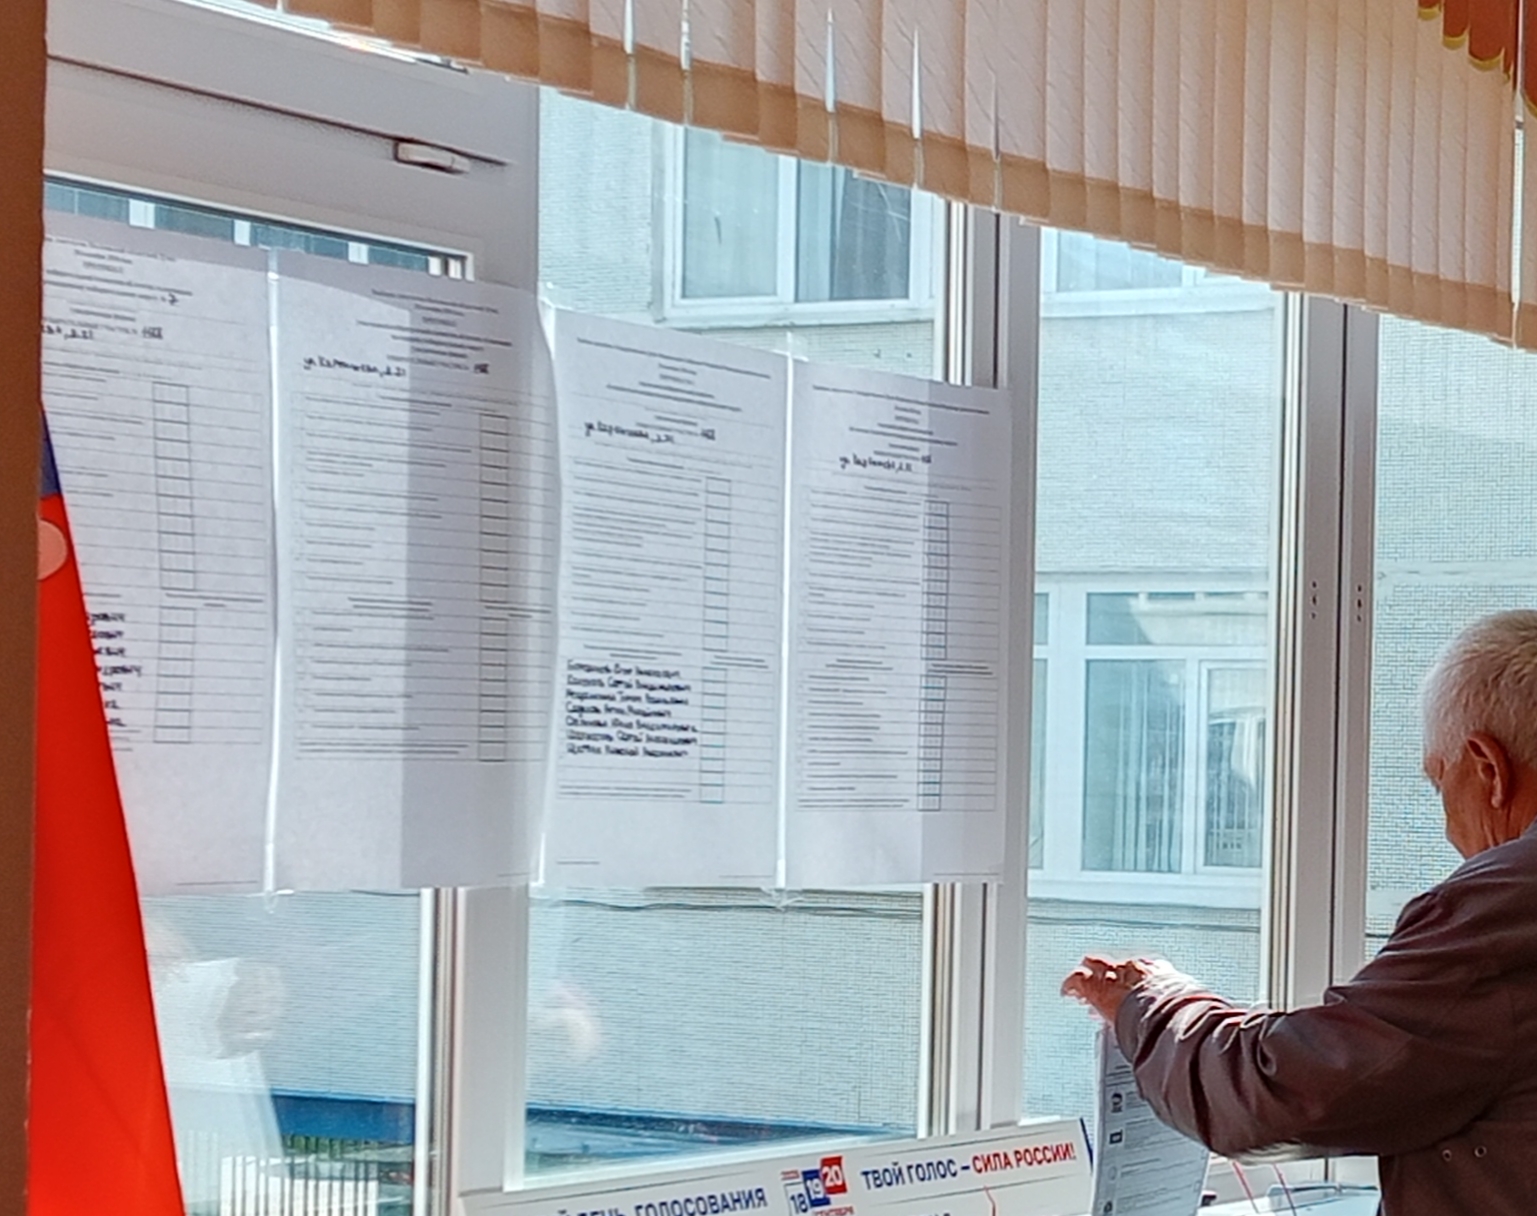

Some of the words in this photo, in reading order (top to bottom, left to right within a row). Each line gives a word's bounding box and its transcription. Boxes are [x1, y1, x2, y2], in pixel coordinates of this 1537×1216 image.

[789, 1193, 808, 1214] 18
[806, 1178, 825, 1200] 19
[821, 1165, 843, 1188] 20
[860, 1161, 905, 1190] ТВОЙ
[908, 1159, 958, 1184] ГОЛОС
[972, 1152, 1014, 1174] СИЛА
[1014, 1142, 1077, 1168] РОССИИ!
